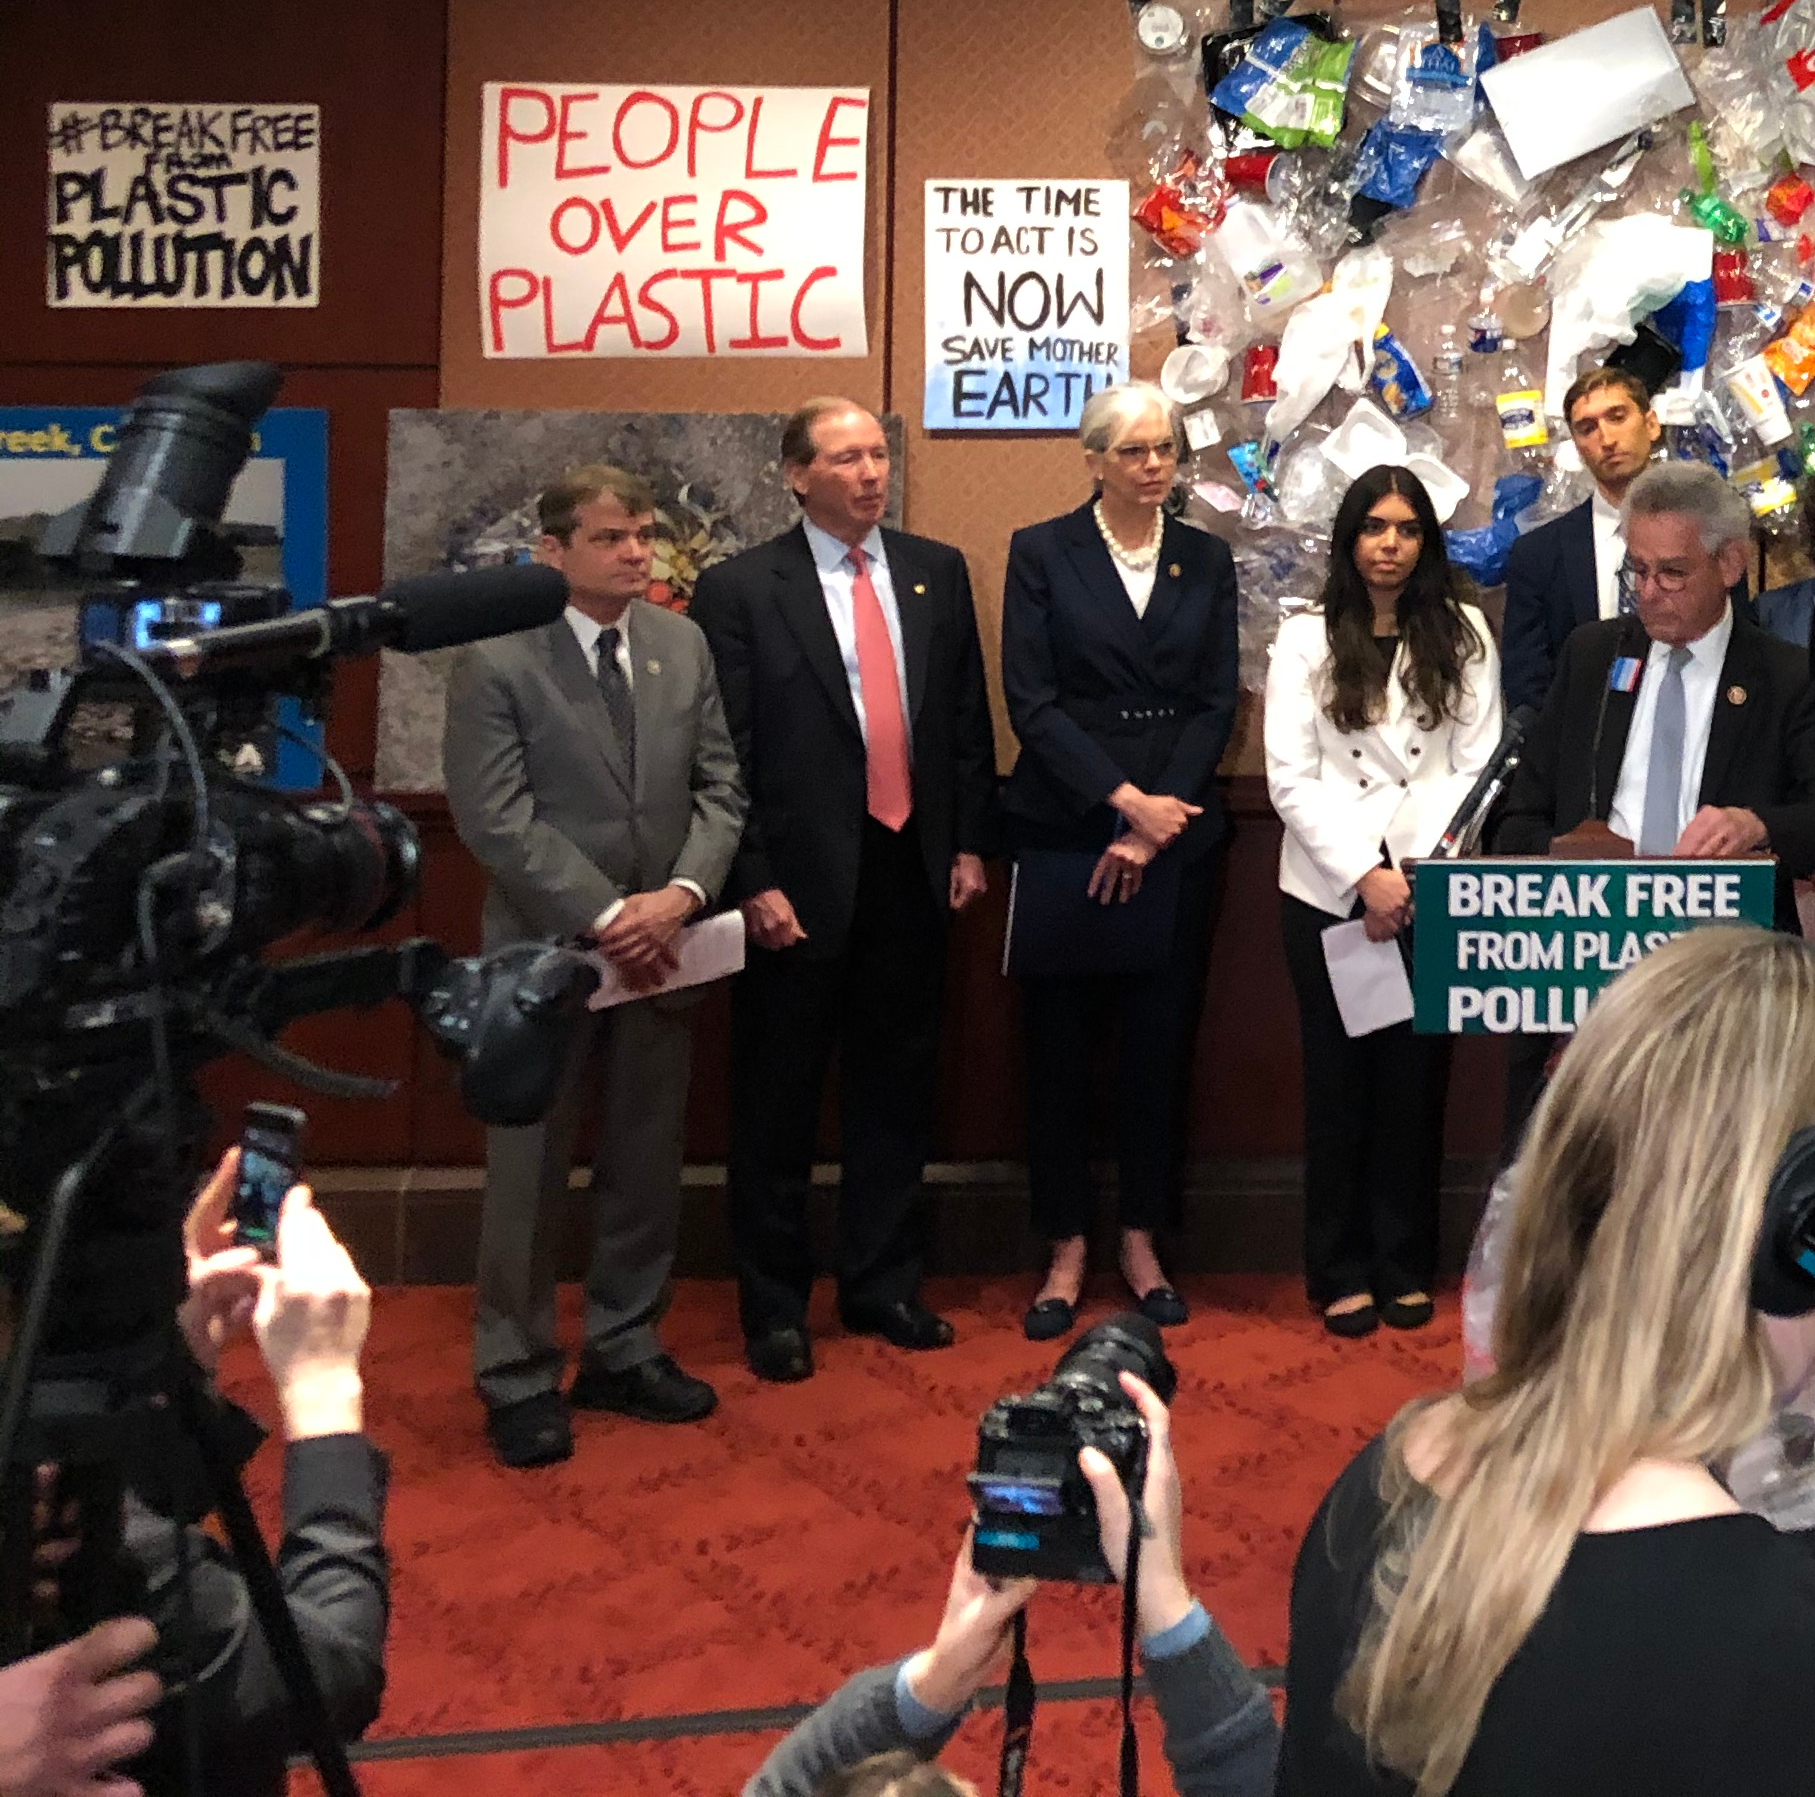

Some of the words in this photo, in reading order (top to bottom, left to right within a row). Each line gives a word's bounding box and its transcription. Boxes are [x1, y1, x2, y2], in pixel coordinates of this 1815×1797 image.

[143, 150, 233, 175] FROM
[497, 88, 868, 189] PEOPLE
[55, 165, 299, 230] PLASTIC
[933, 186, 995, 217] THE
[1016, 186, 1101, 217] TIME
[549, 189, 769, 262] OVER
[935, 227, 984, 255] TO
[990, 225, 1054, 255] ACT
[1067, 226, 1099, 257] IS
[47, 230, 314, 301] POLLUTION
[489, 265, 842, 354] PLASTIC
[963, 267, 1104, 332] NOW
[941, 335, 1014, 366] SAVE
[1028, 336, 1119, 366] MOTHER
[1447, 873, 1611, 918] BREAK
[1626, 873, 1741, 918] FREE
[1456, 930, 1565, 971] FROM
